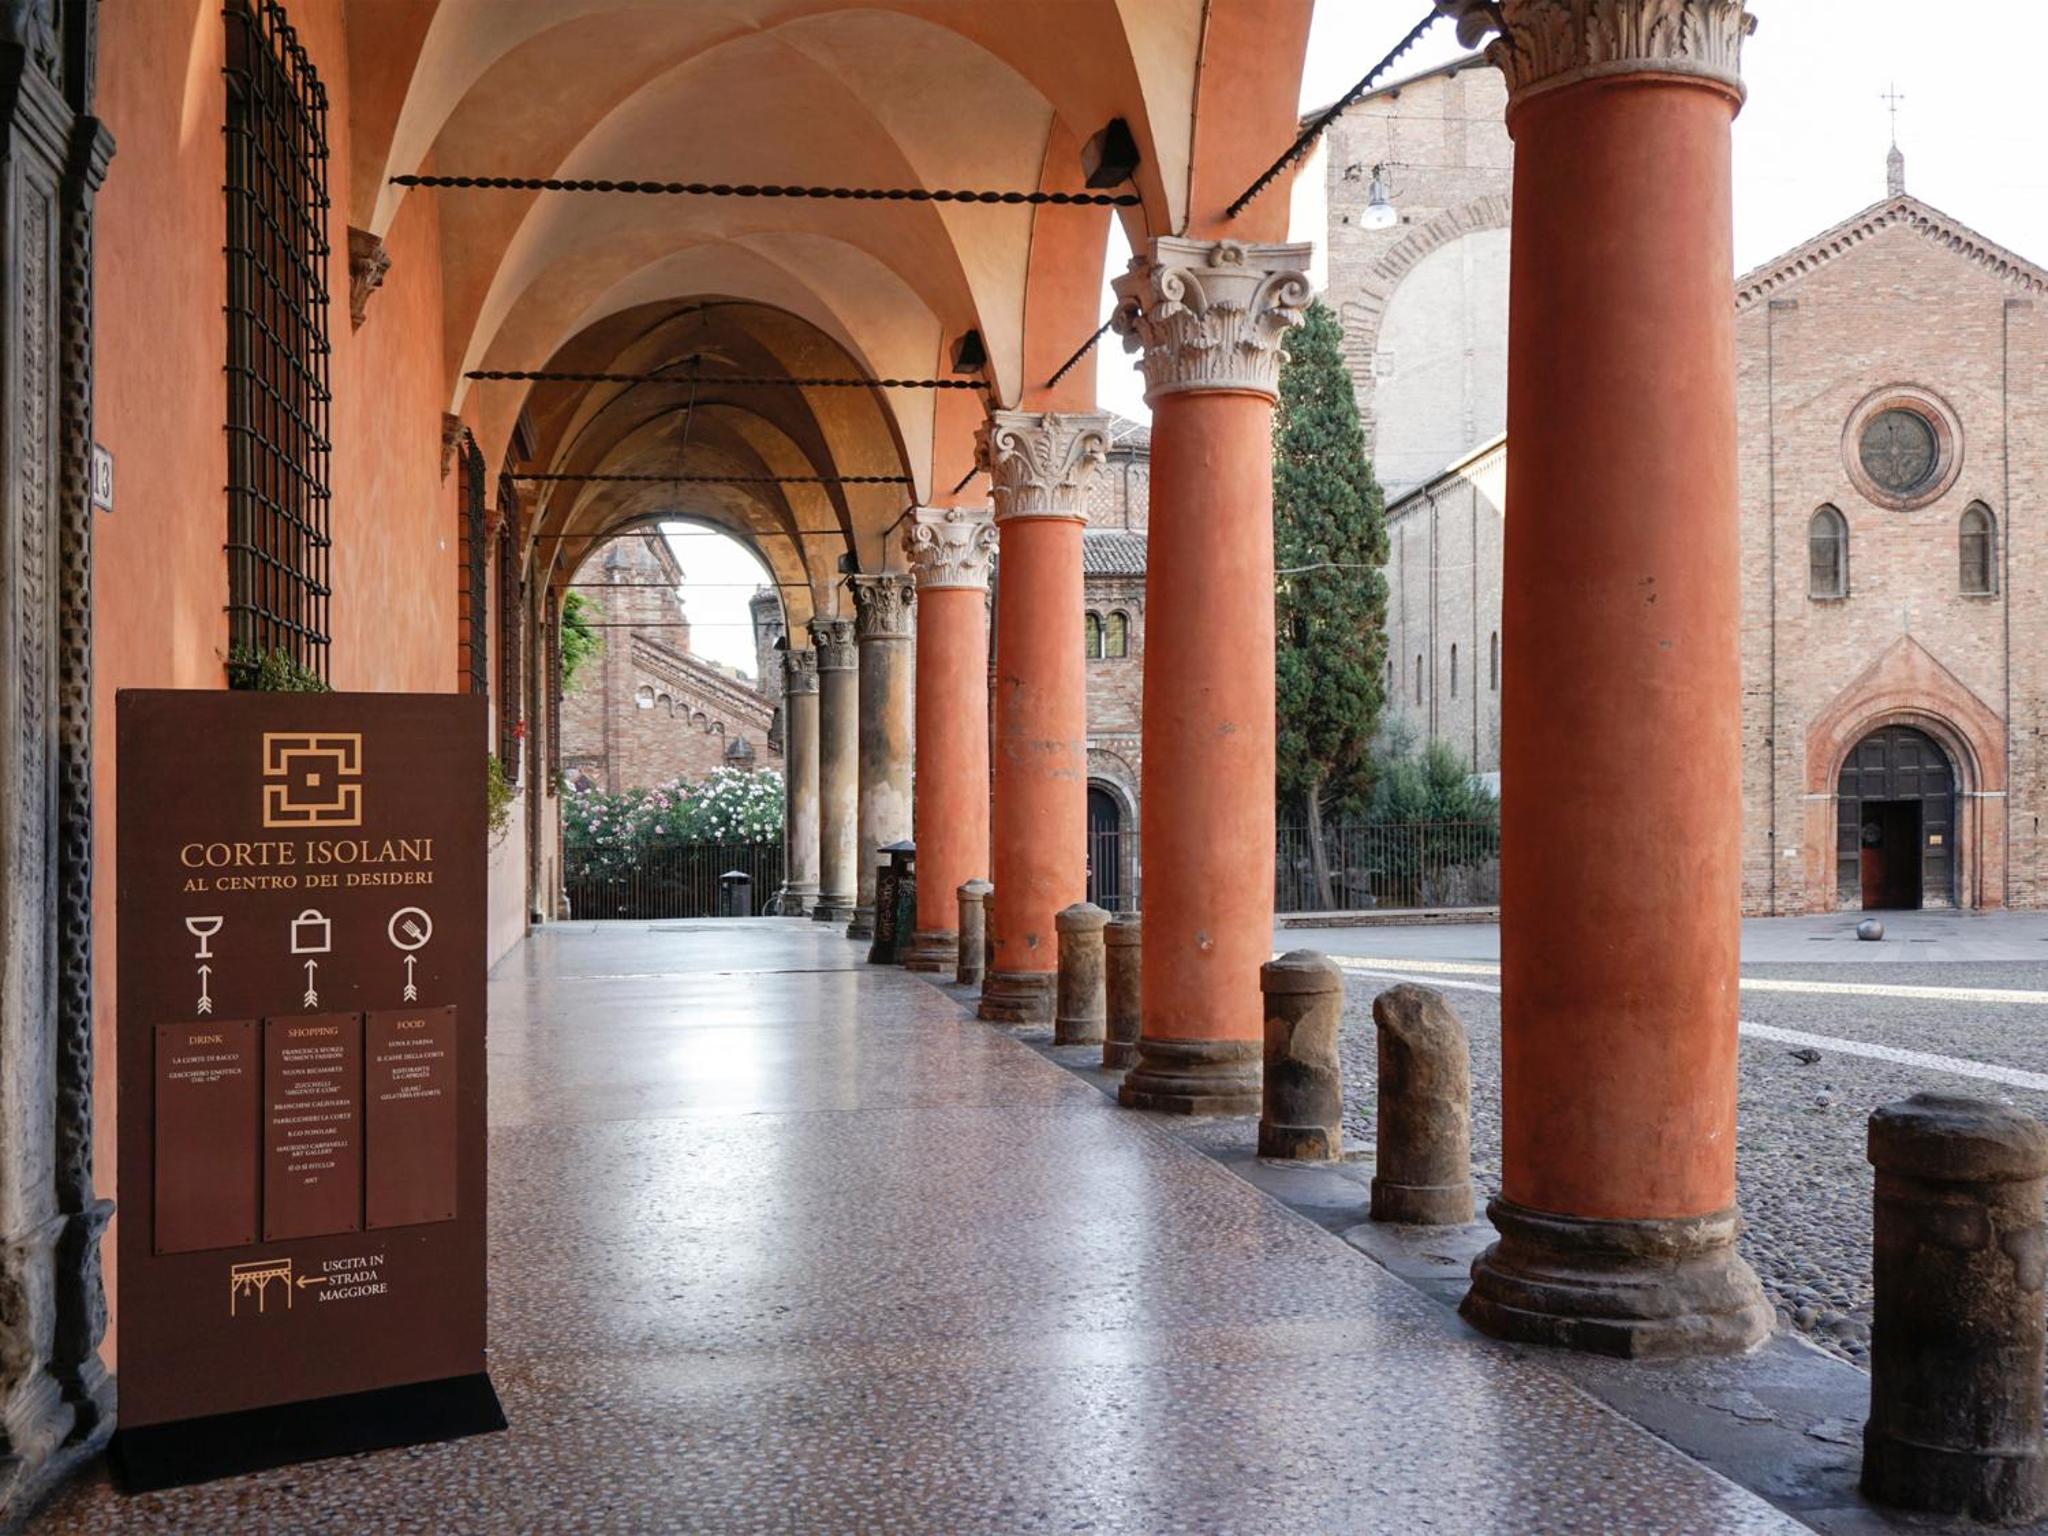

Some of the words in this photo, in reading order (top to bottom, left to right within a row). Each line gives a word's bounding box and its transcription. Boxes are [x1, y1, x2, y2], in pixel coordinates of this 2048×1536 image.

[180, 842, 296, 868] CORTE
[305, 838, 433, 864] ISOLANI
[184, 877, 209, 892] AL
[216, 875, 298, 891] CENTRO
[304, 873, 338, 888] DEI
[347, 871, 434, 886] DESIDERI
[288, 1026, 339, 1037] SHOPPING
[396, 1020, 425, 1029] FOOD
[189, 1034, 224, 1045] DRINK
[322, 1257, 367, 1272] USCITA
[370, 1254, 384, 1266] IN
[329, 1270, 378, 1286] STRADA
[319, 1282, 388, 1302] MAGGIORE
